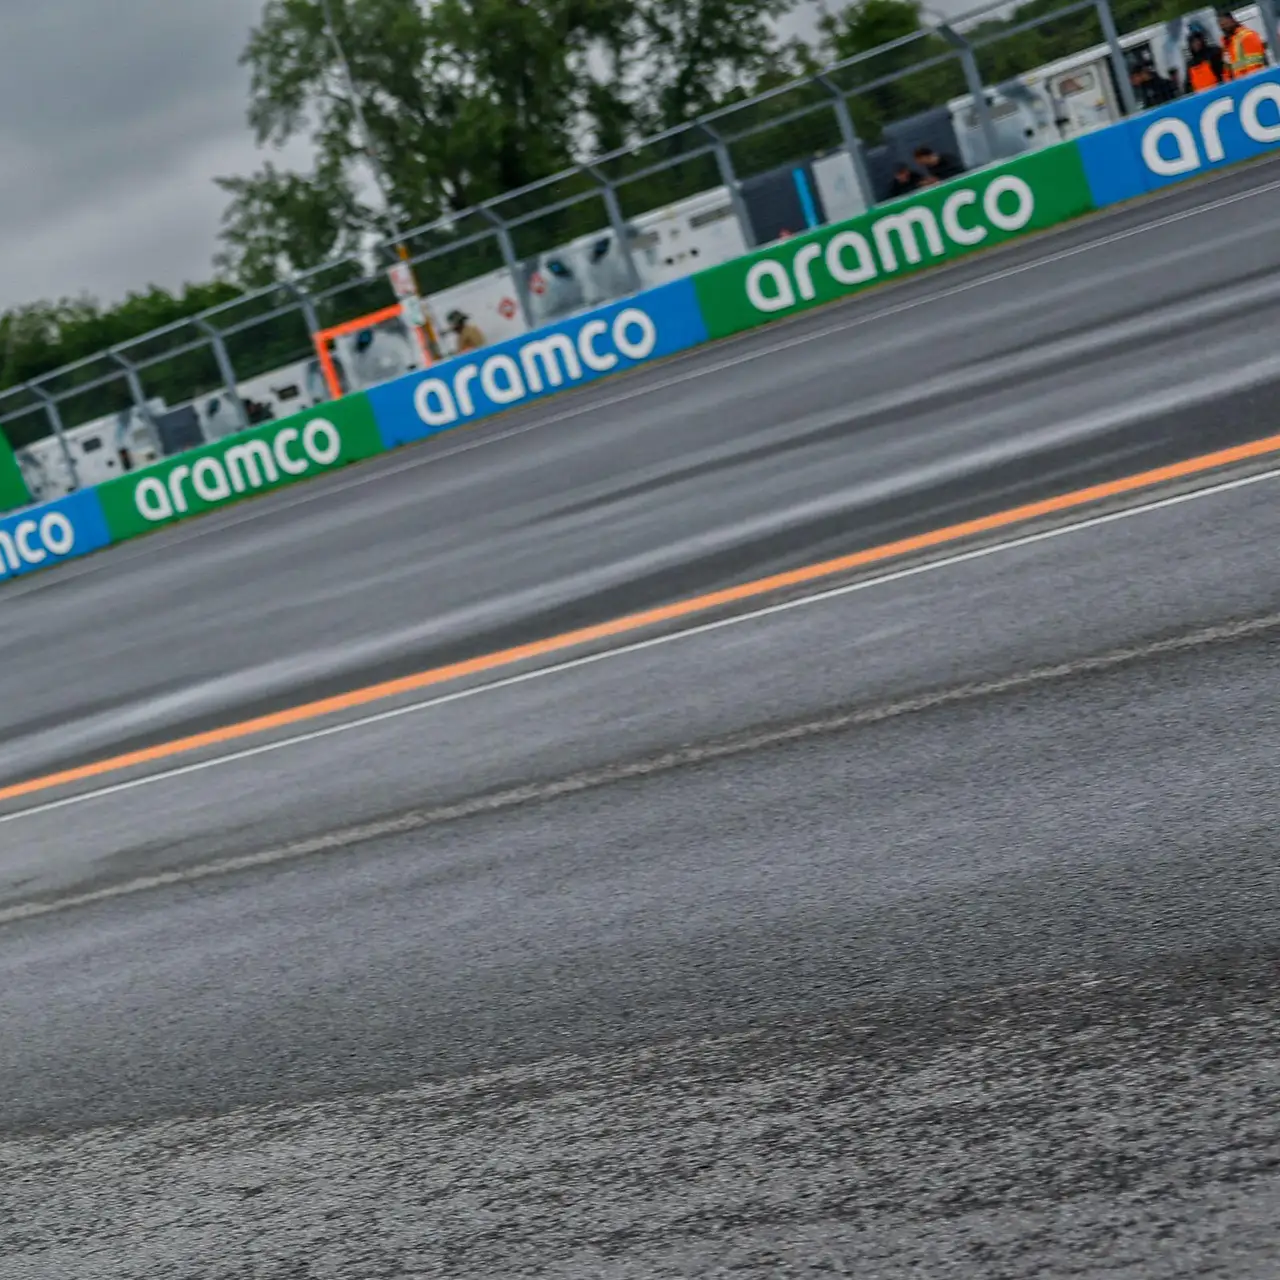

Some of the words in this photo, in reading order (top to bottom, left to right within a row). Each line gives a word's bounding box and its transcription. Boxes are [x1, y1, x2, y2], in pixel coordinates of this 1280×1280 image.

[746, 175, 1034, 313] aramco
[414, 308, 657, 427] aramco
[134, 418, 340, 522] aramco
